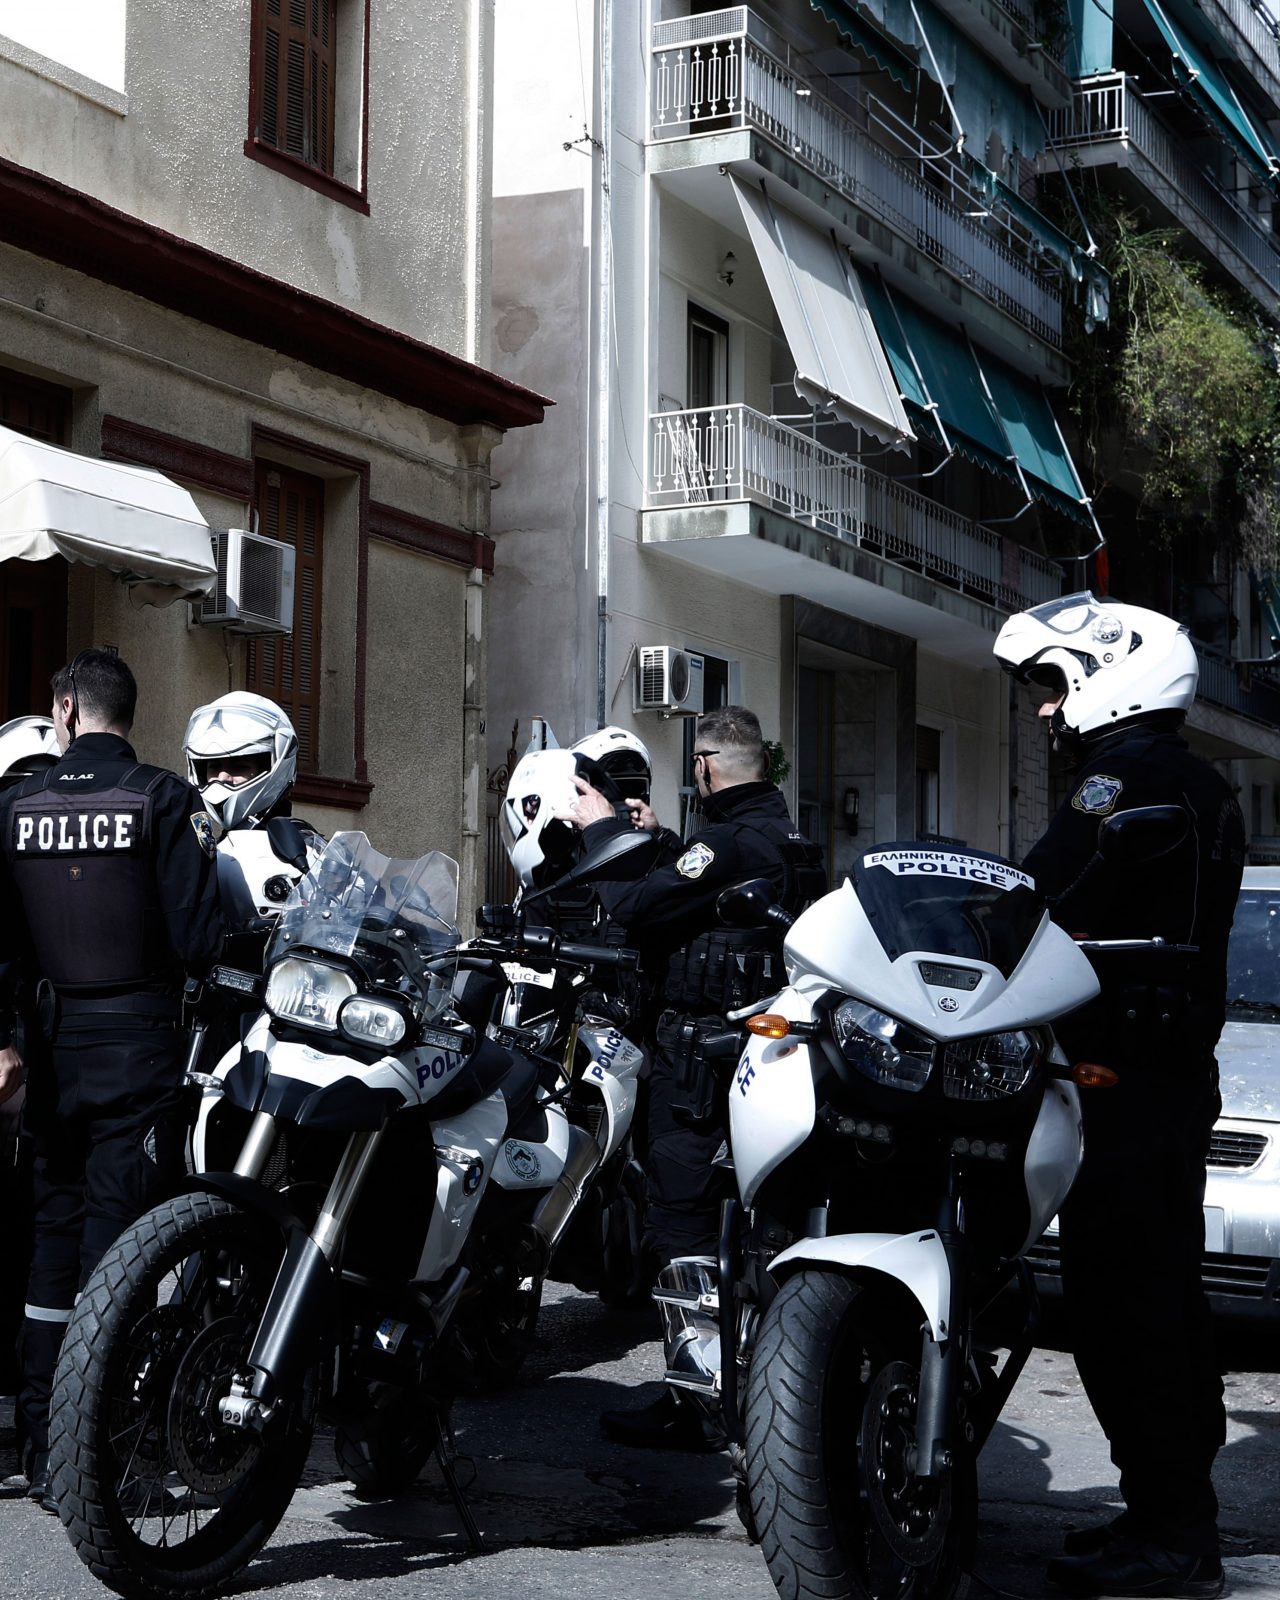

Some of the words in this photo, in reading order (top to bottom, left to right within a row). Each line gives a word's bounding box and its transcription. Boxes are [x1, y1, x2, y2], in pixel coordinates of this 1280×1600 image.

[17, 813, 133, 851] POLICE
[871, 852, 945, 863] ΕΛΛΗΝΙΚΗ
[949, 855, 1029, 884] ΑΣΤΥΝΟΜΙΑ
[898, 862, 1007, 887] POLICE
[506, 972, 541, 983] OLICE
[416, 1050, 462, 1089] POLI
[591, 1030, 624, 1081] POLICE
